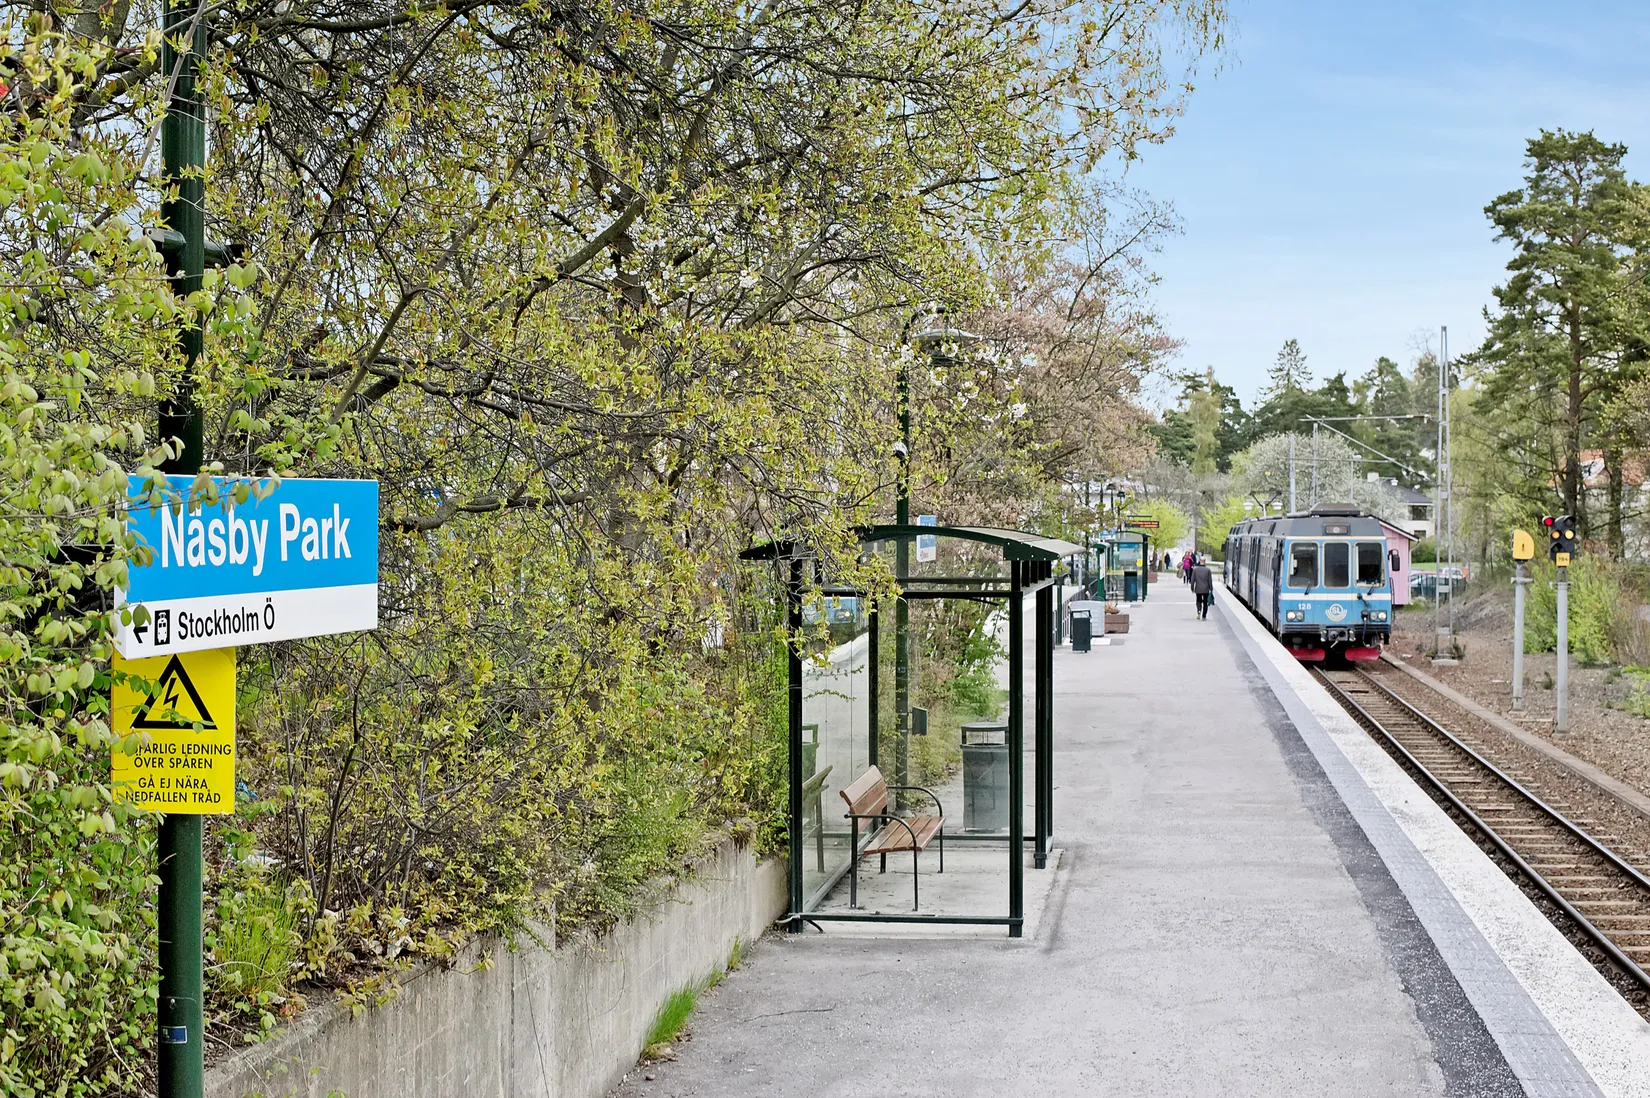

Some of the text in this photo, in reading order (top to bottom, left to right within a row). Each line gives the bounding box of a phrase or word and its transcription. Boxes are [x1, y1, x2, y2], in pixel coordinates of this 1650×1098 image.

[161, 503, 352, 576] Näsby Park
[178, 597, 275, 640] Stockholm Ö
[181, 743, 232, 756] LEDNING
[134, 753, 213, 769] ÖVER SPÅREN
[138, 774, 208, 789] GÅ EJ NÄRA
[125, 789, 221, 804] NEDFALLEN TRÅD
